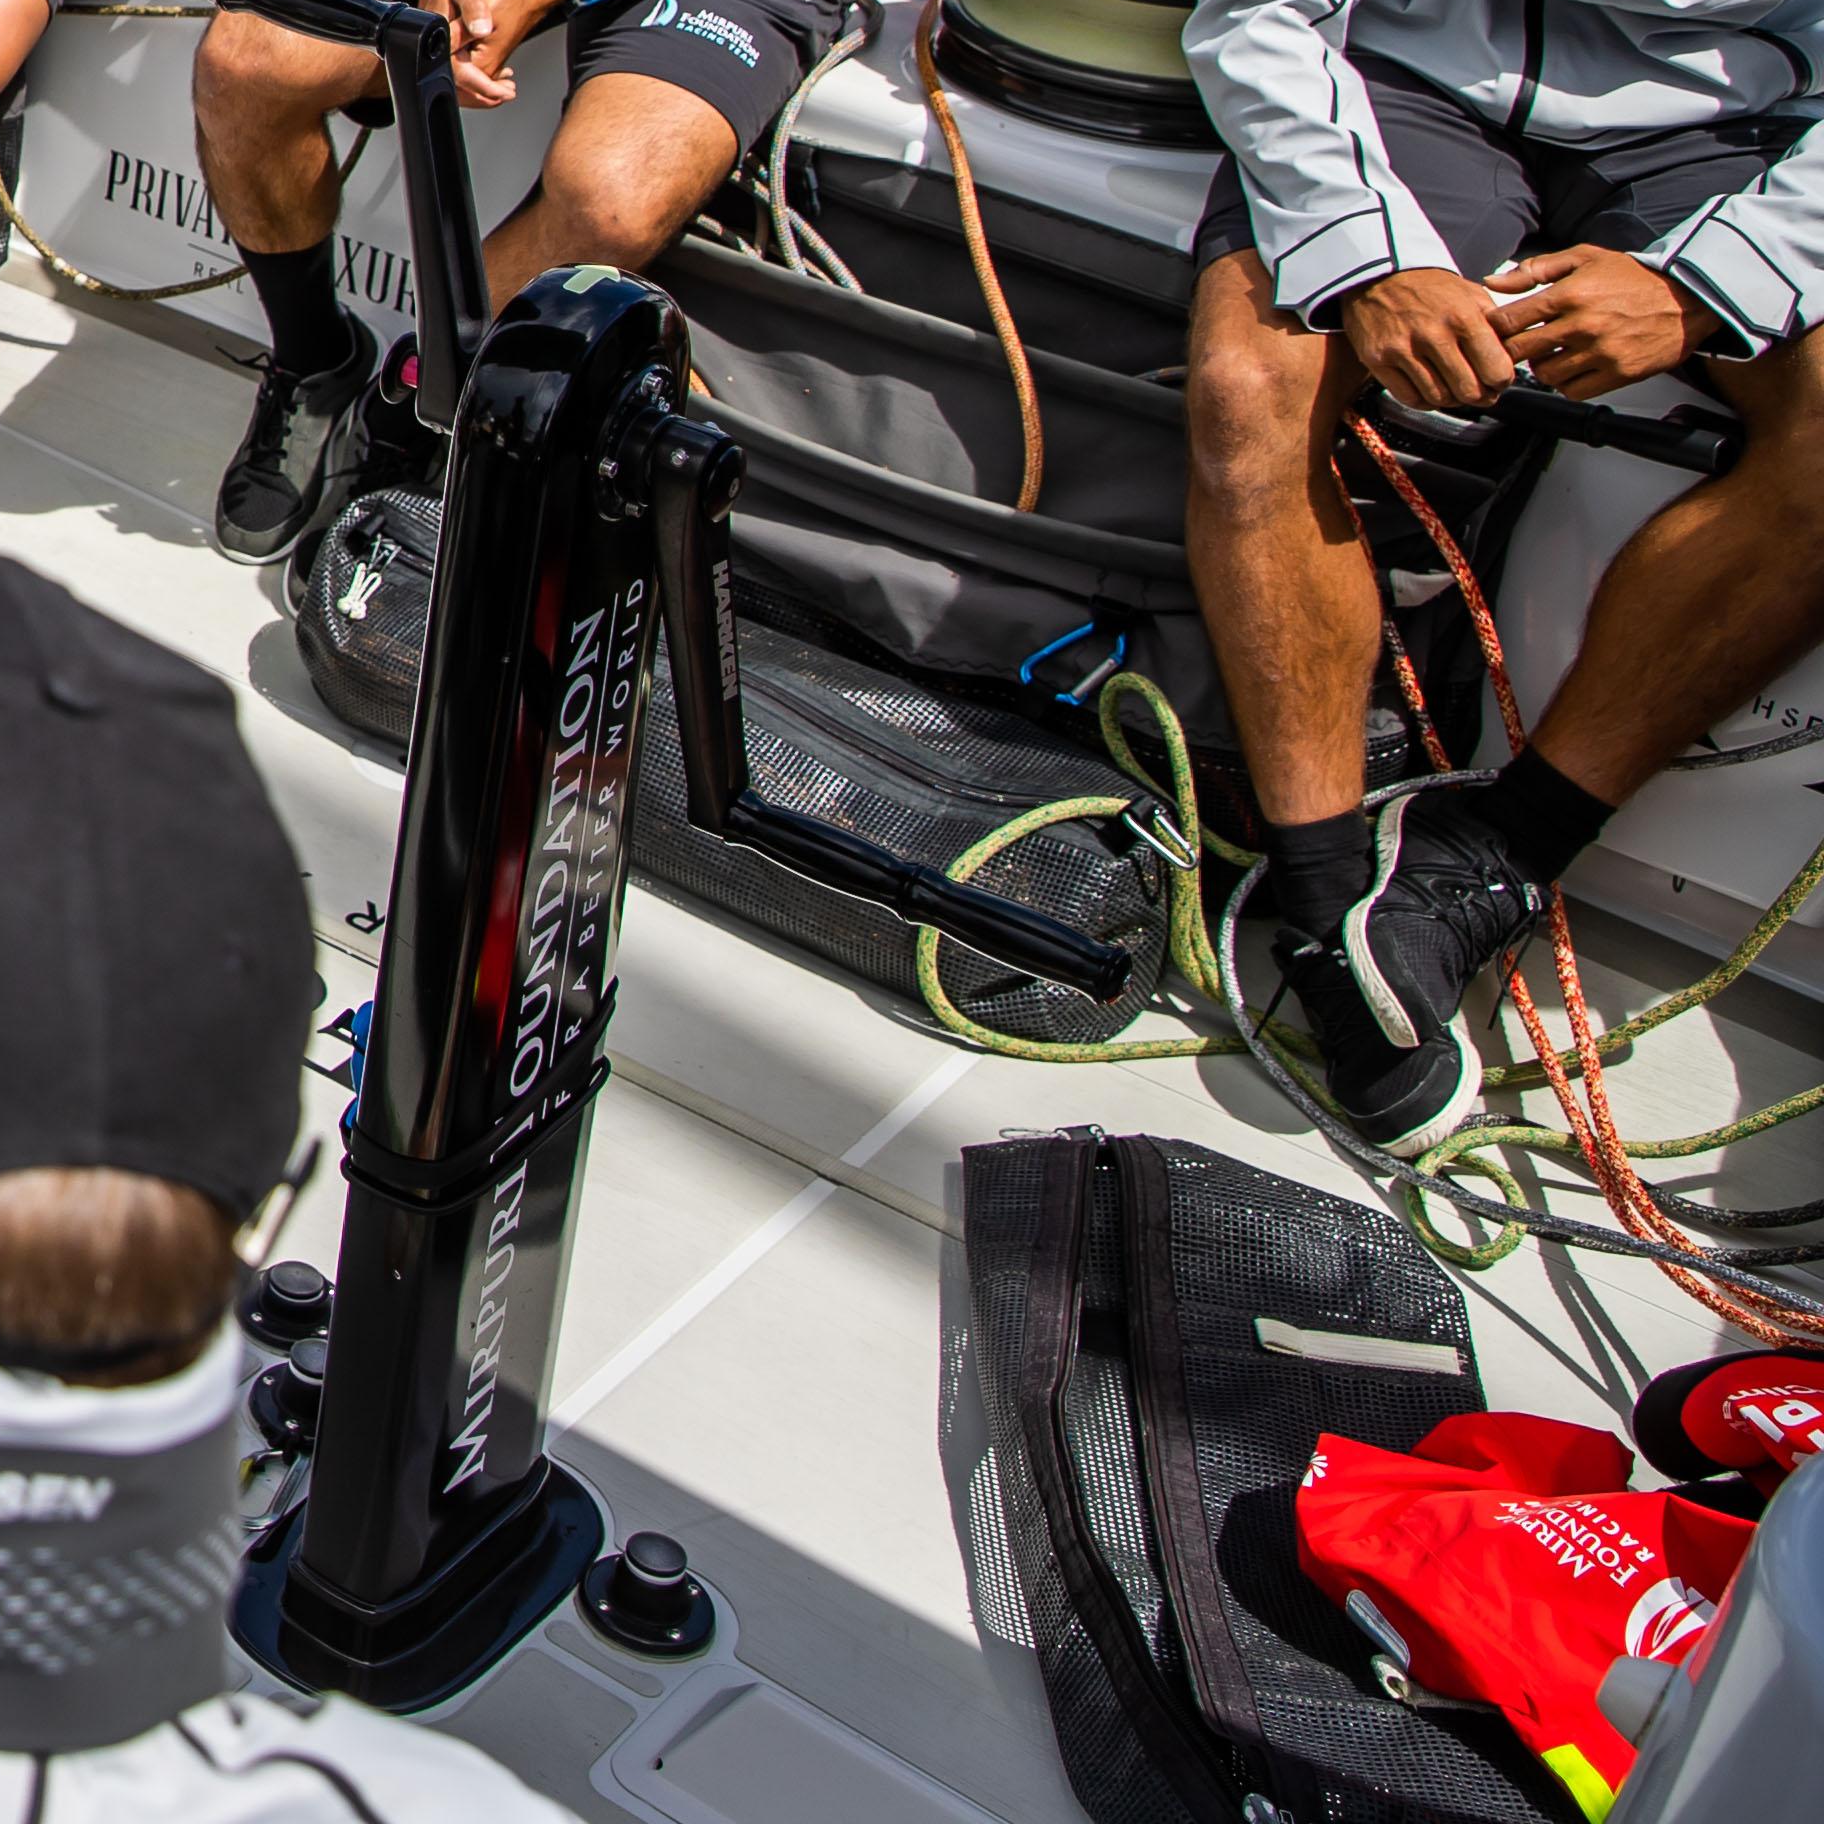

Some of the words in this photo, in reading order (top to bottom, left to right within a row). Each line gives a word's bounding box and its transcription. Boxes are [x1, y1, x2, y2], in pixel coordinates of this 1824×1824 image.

[675, 22, 726, 46] RACING
[727, 43, 757, 69] TEAM
[679, 11, 761, 61] FOUNDATION
[696, 9, 754, 44] MIRPURI
[104, 149, 233, 246] PRIVA
[334, 231, 417, 318] XUR
[605, 578, 646, 758] WORLD
[711, 559, 739, 702] HARKEN
[577, 777, 618, 948] BETTER
[571, 964, 590, 993] A
[553, 1017, 584, 1119] FR
[442, 1159, 528, 1495] MIRPURI
